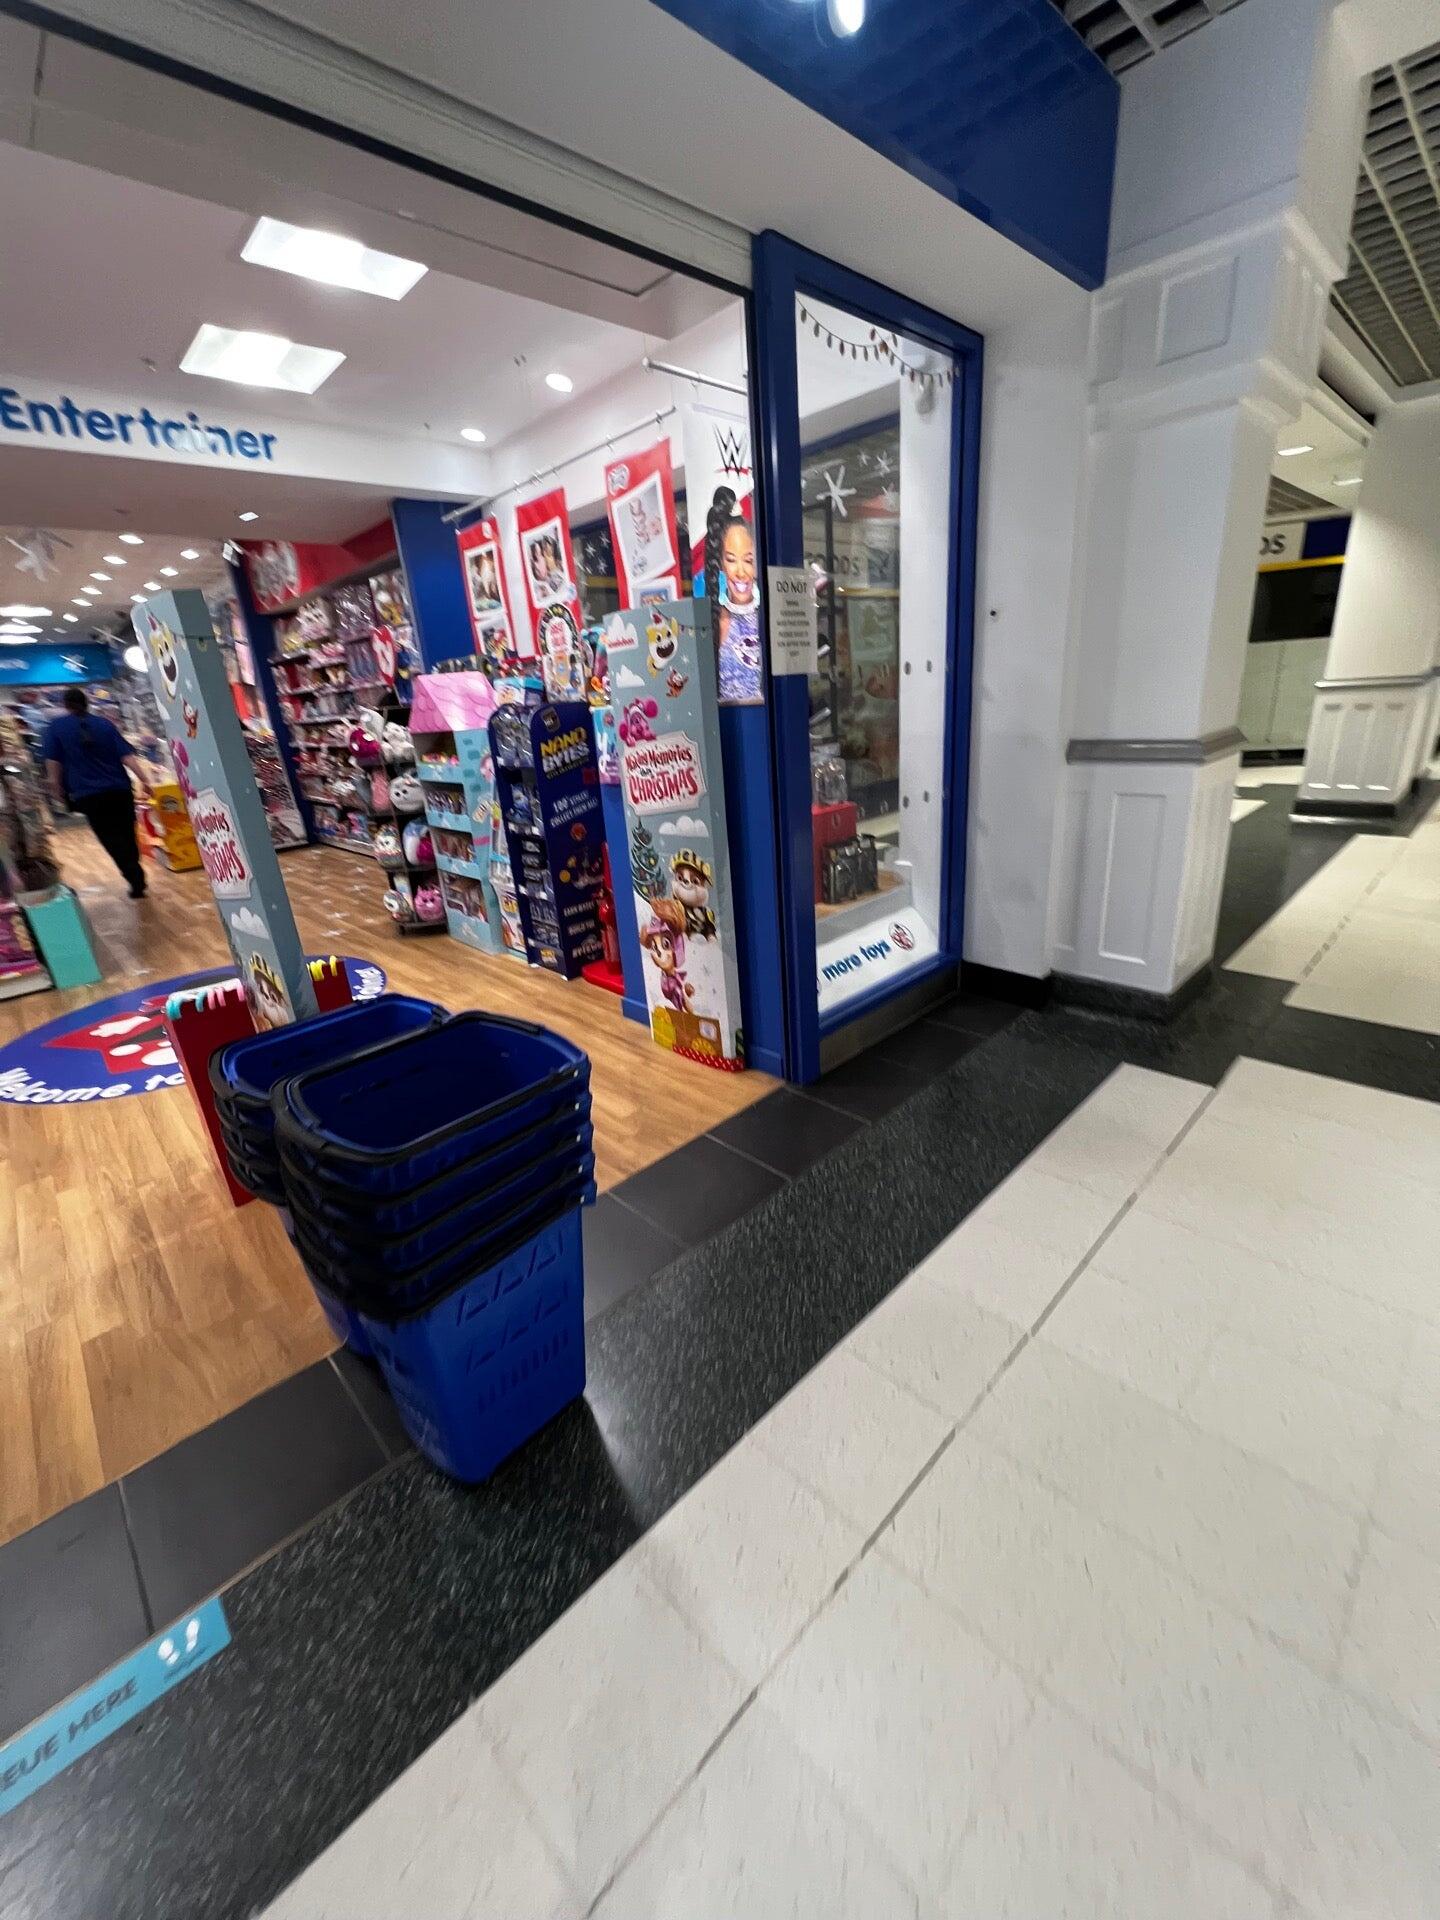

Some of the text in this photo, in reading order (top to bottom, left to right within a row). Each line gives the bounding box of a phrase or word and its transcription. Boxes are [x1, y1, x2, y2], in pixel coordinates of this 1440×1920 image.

[629, 767, 698, 804] CHRISTMAS
[822, 940, 891, 982] more toys
